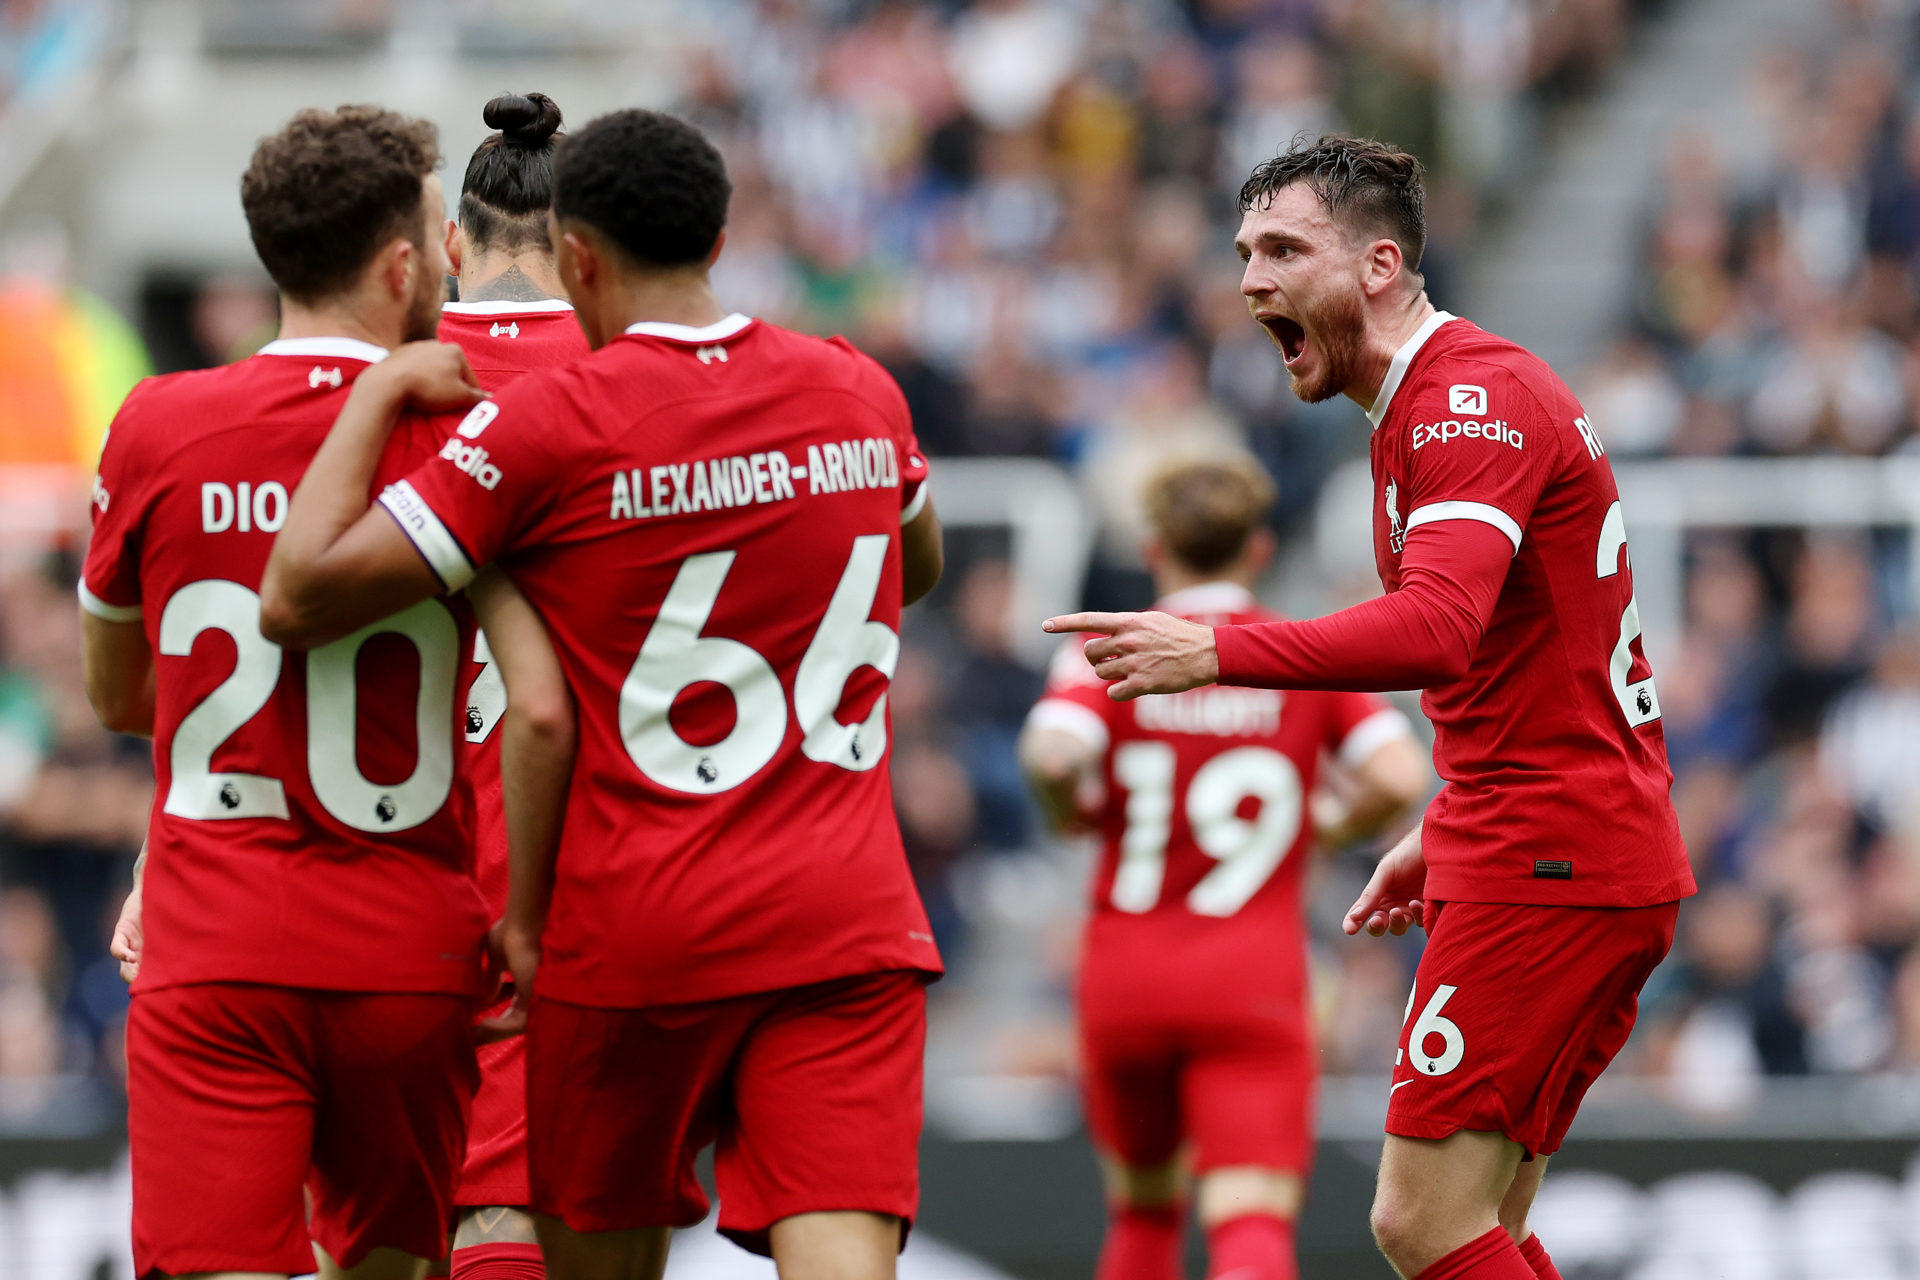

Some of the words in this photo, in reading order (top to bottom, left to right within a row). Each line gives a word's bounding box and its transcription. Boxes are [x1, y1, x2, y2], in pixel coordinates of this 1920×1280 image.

[439, 437, 503, 491] edia
[1412, 420, 1524, 451] Expedia
[159, 579, 460, 833] 20
[618, 533, 900, 795] 66
[1110, 739, 1304, 917] 19
